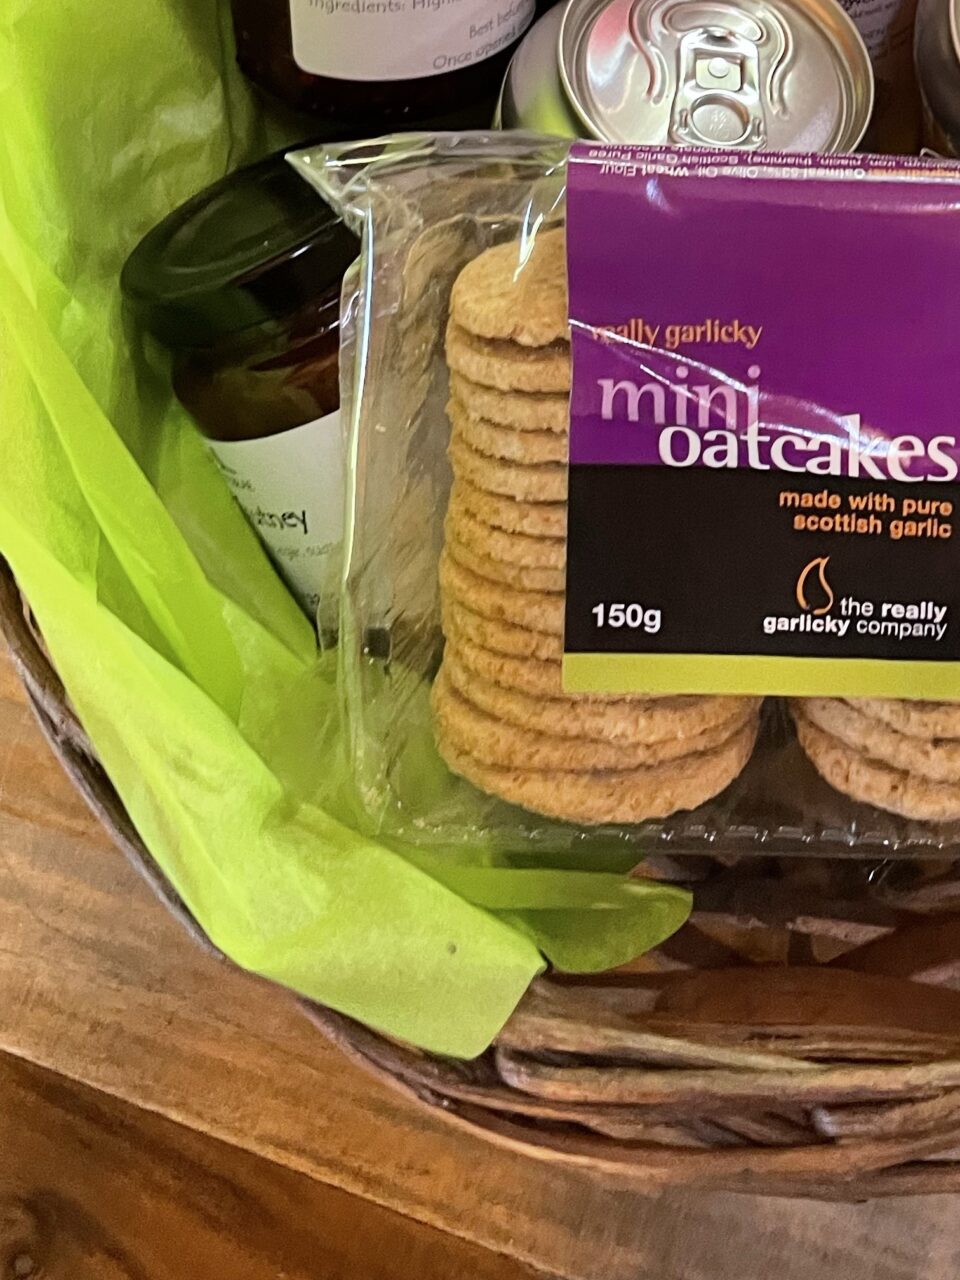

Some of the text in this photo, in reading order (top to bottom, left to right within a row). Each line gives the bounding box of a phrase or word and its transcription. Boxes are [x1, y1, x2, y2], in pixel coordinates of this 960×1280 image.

[469, 17, 495, 39] Best
[432, 50, 473, 70] Once
[640, 163, 690, 178] Wheat
[664, 318, 763, 350] garlicky
[597, 364, 762, 431] mini
[658, 412, 959, 483] oatcakes
[779, 488, 954, 517] made with pure
[793, 513, 953, 540] scottish garlic
[591, 602, 662, 635] 150g
[839, 596, 948, 624] the really
[763, 613, 948, 641] garlicky company
